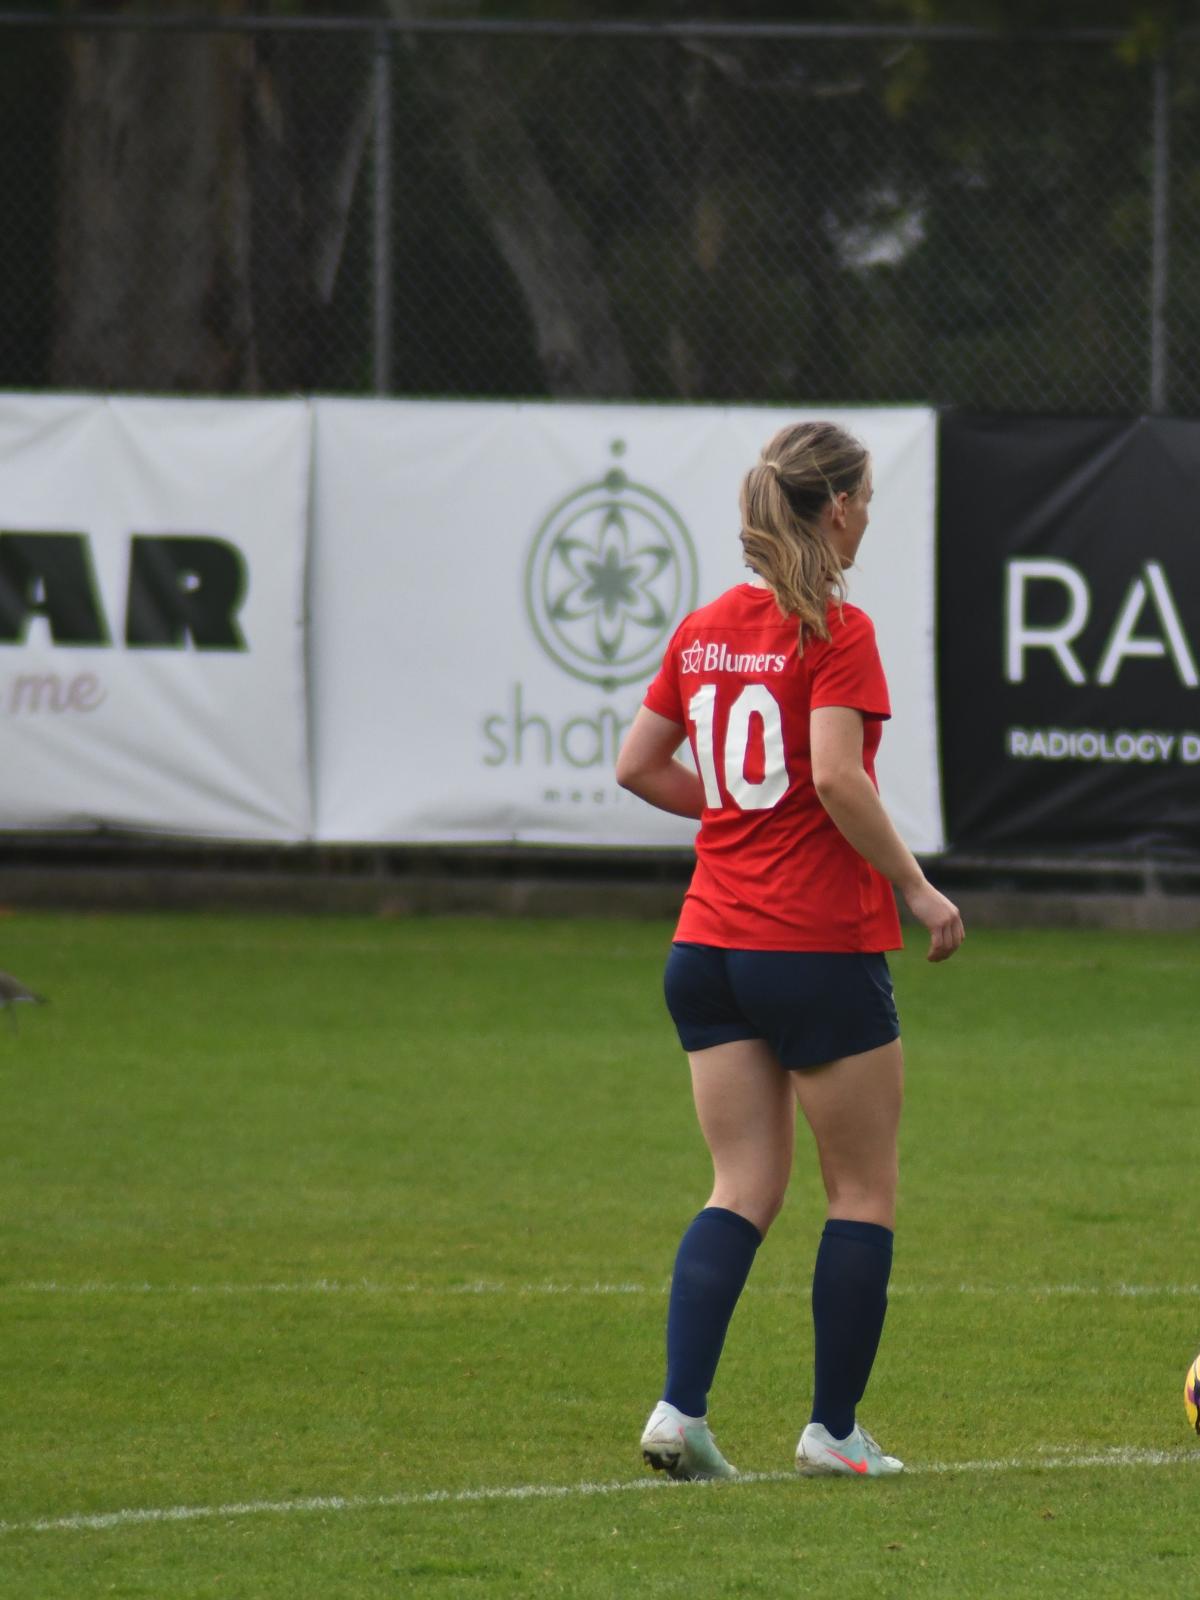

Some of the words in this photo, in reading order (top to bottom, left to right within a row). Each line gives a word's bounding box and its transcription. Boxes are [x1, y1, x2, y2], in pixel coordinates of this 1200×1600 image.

[703, 643, 786, 673] Blumers
[688, 683, 790, 811] 10
[1010, 731, 1174, 761] RADIOLOGY
